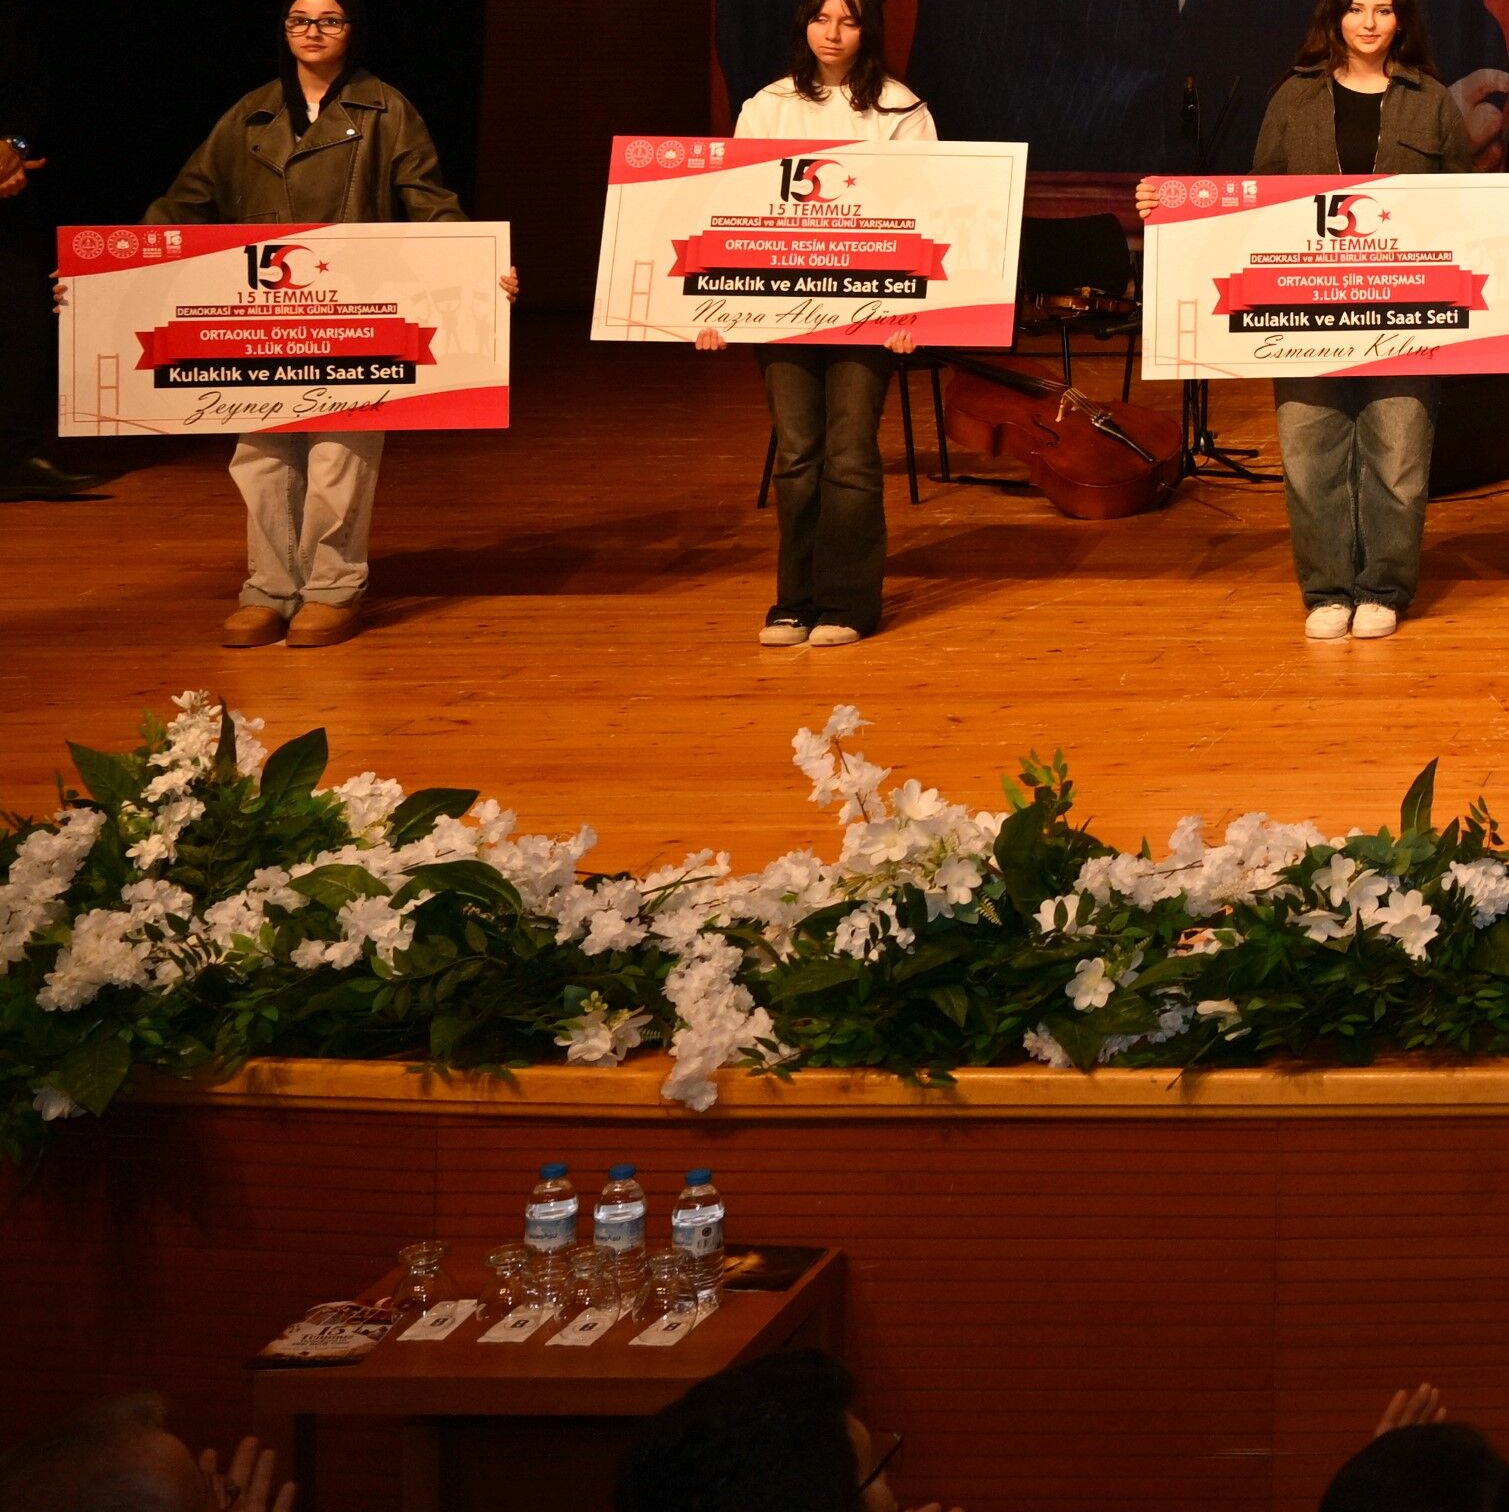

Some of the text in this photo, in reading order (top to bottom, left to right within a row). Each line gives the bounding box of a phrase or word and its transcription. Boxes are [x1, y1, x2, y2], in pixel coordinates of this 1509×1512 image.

[769, 203, 862, 216] 15 TEMMUZ
[726, 239, 897, 252] ORTAOKUL RESİM KATEGORİSİ
[1307, 239, 1398, 251] 15 TEMMUZ
[770, 254, 849, 266] 3.LÜK ÖDÜLÜ
[697, 276, 916, 293] Kulaklık ve Akıllı Saat Seti
[1278, 274, 1425, 287] ORTAOKUL ŞİİR YARIŞMASI
[237, 290, 338, 303] 15 TEMMUZ
[1312, 289, 1391, 300] 3.LÜK ÖDÜLÜ
[177, 306, 231, 316] DEMOKRASİ
[247, 305, 272, 315] MİLLİ
[275, 305, 304, 314] BİRLİK
[307, 305, 334, 314] GÜNÜ
[337, 305, 396, 314] YARIŞMALARI
[1242, 310, 1459, 327] Kulaklık ve Akıllı Saat Seti
[201, 327, 374, 341] ORTAOKUL ÖYKÜ YARIŞMASI
[245, 342, 330, 355] 3.LÜK ÖDÜLÜ
[169, 364, 404, 382] Kulaklık ve Akıllı Saat Seti
[184, 388, 390, 425] Zeynep Şimşek
